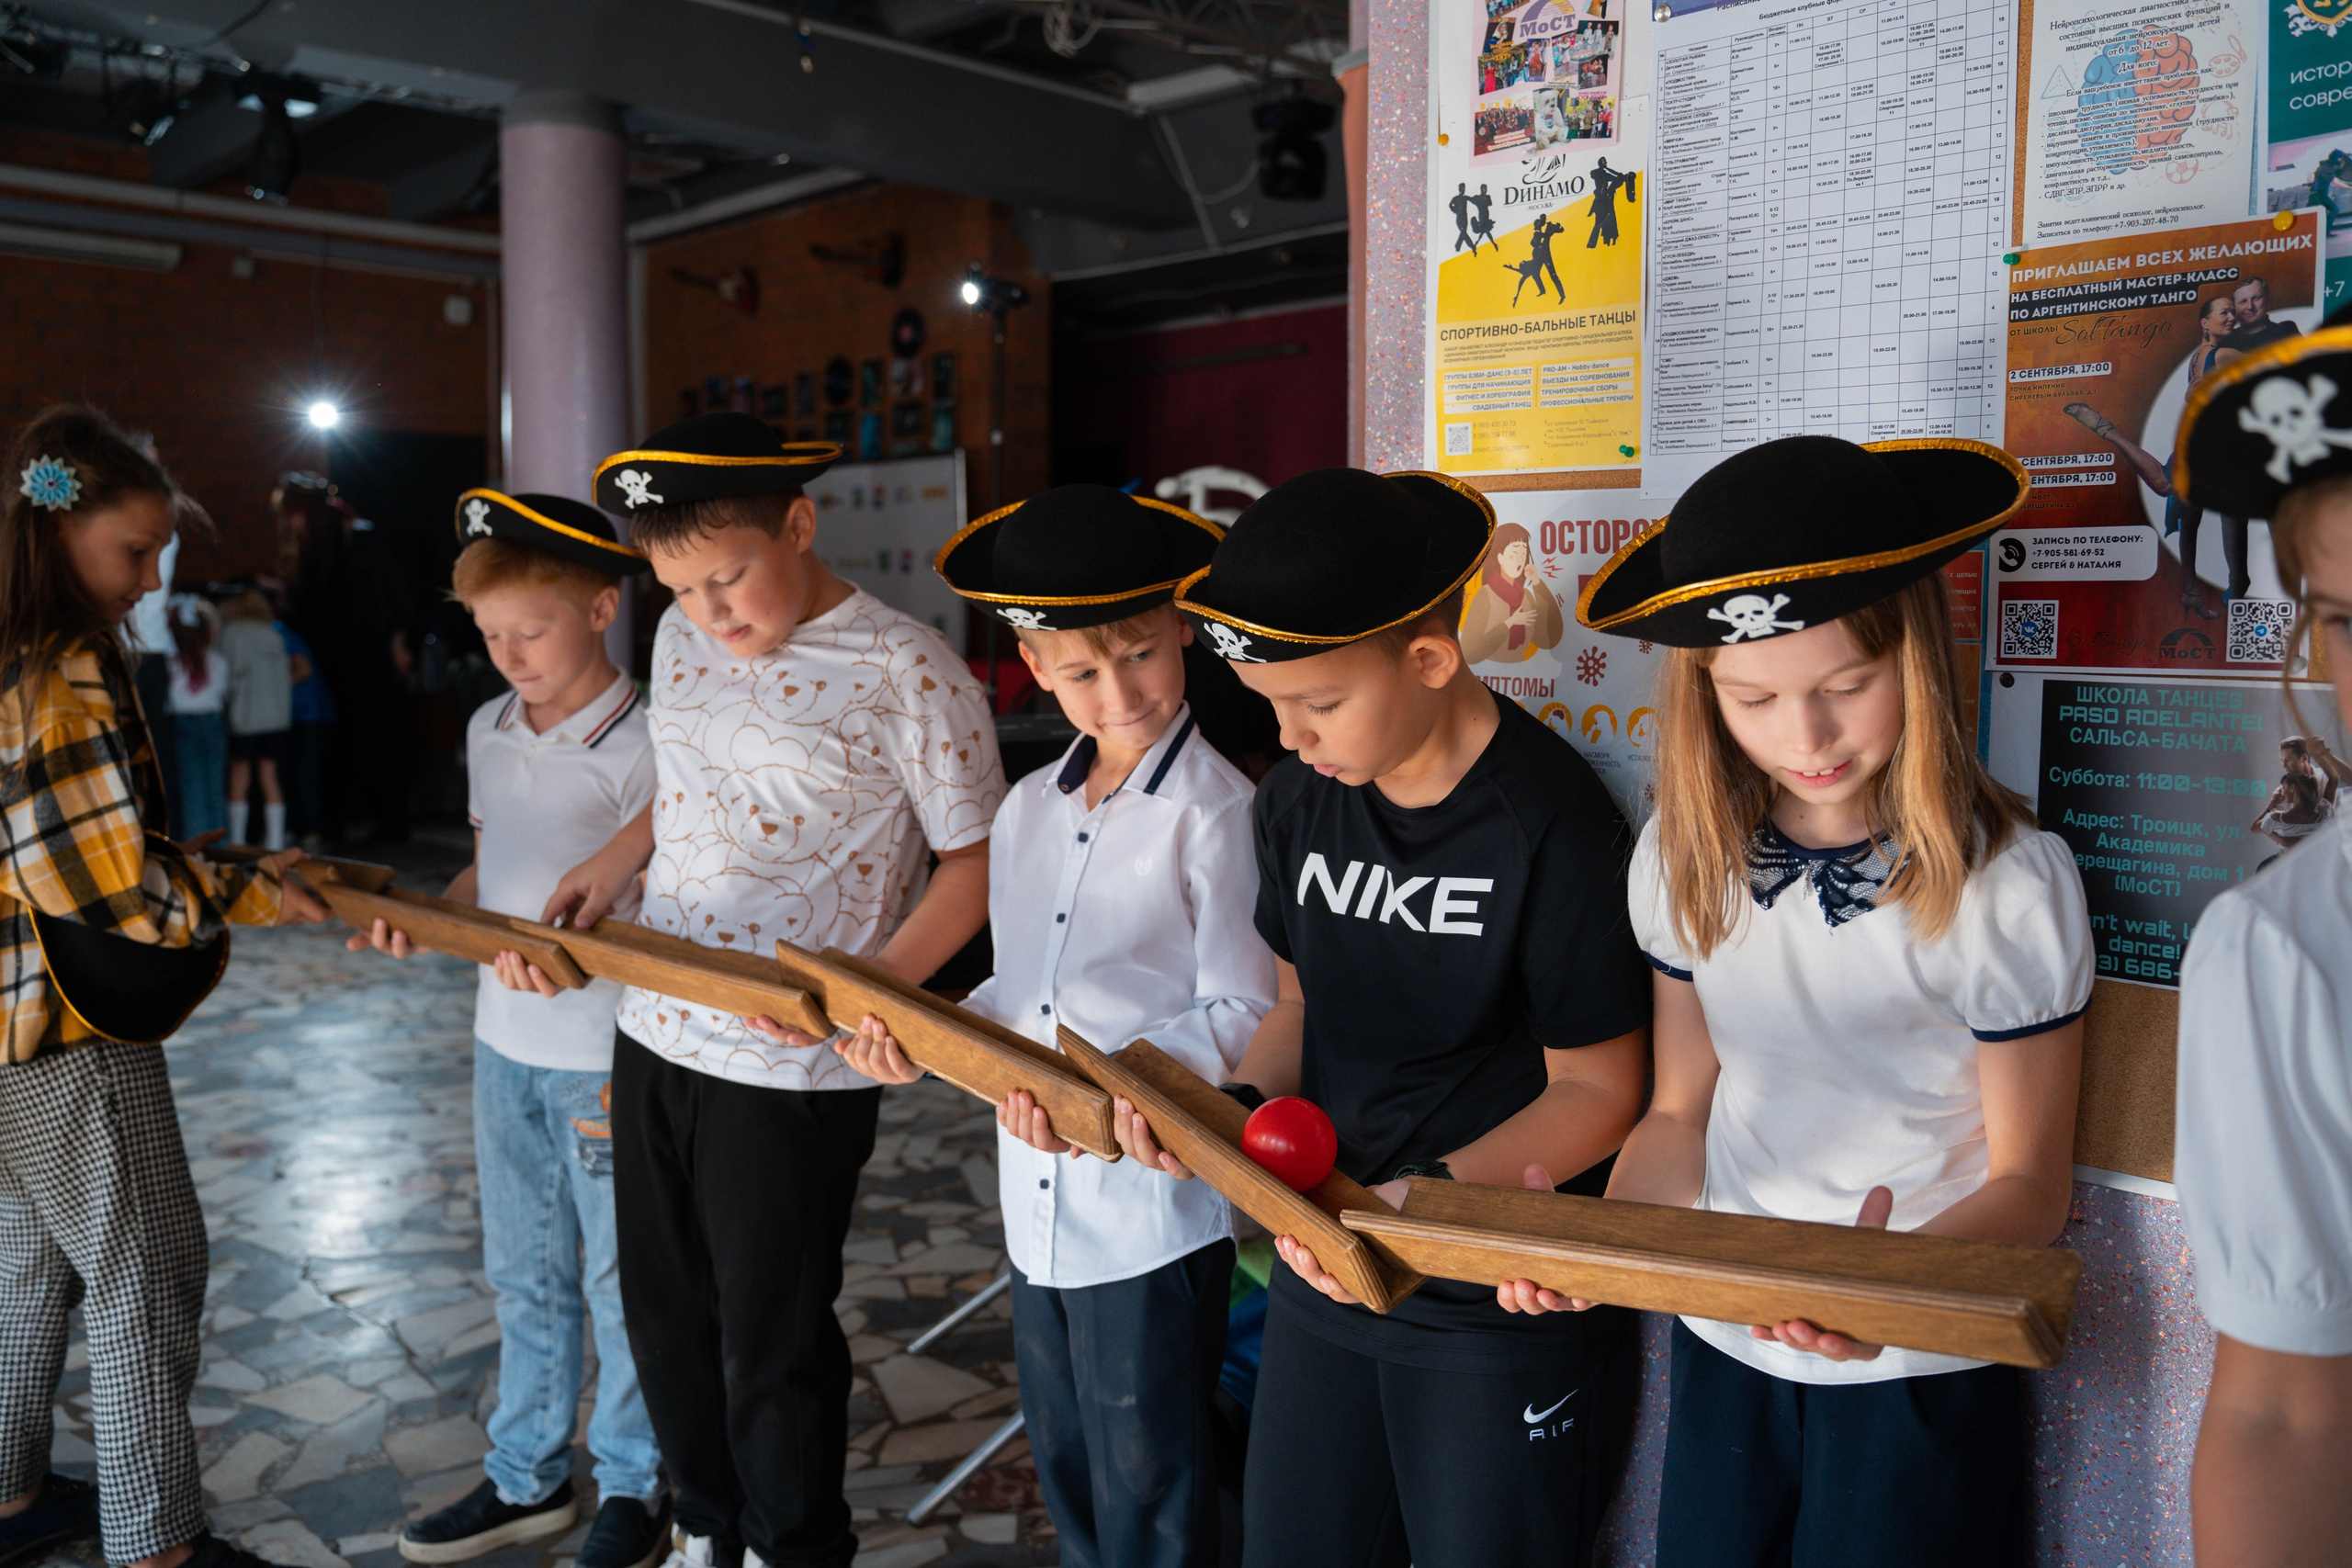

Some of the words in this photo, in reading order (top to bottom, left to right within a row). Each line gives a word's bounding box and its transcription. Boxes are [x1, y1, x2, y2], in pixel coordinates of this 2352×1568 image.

[1758, 7, 1796, 20] Бюджетные
[1797, 1, 1825, 12] клубные
[2050, 8, 2136, 31] Нейропсихологическая
[2059, 28, 2096, 40] состояния
[2098, 22, 2129, 33] высших
[2132, 13, 2182, 27] психических
[2185, 3, 2222, 18] функций
[1520, 14, 1576, 37] МоСТ
[2065, 35, 2126, 52] индивидуальная
[2129, 23, 2194, 39] нейрокоррекция
[2197, 16, 2221, 28] детей
[2118, 45, 2124, 54] 6
[2129, 45, 2140, 53] до
[2143, 40, 2153, 51] 12
[2154, 40, 2171, 49] лет.
[2118, 62, 2134, 73] Для
[2137, 60, 2158, 69] кого:
[2066, 89, 2082, 97] Если
[2097, 82, 2121, 93] ребенок
[2164, 70, 2199, 80] проблемы,
[2048, 107, 2078, 117] школьные
[2081, 102, 2112, 113] трудности
[2115, 97, 2140, 108] (низкая
[2188, 84, 2223, 95] трудности
[2092, 111, 2118, 120] ошибки
[2130, 103, 2168, 114] математике,
[2161, 122, 2193, 130] внимания
[2196, 116, 2234, 127] (трудности
[2045, 169, 2085, 179] двигательная
[2148, 154, 2172, 164] низкий
[2174, 151, 2223, 161] самоконтроль,
[2044, 179, 2088, 188] конфликтность
[2086, 183, 2108, 193] ЗПРР
[2037, 220, 2062, 229] Занятия
[2081, 212, 2120, 223] клинический
[2122, 209, 2153, 219] психолог,
[2154, 204, 2205, 214] нейропсихолог.
[2037, 230, 2071, 239] Записаться
[2083, 224, 2113, 233] телефону:
[2114, 215, 2178, 229] +7-903-207-48-70
[2011, 255, 2131, 283] ПРИГЛАШАЕМ
[2136, 249, 2184, 267] ВСЕХ
[2188, 233, 2313, 262] ЖЕЛАЮЩИХ
[2011, 292, 2029, 303] НА
[2031, 277, 2122, 301] БЕСПЛАТНЫЙ
[2126, 267, 2238, 289] МАСТЕР-КЛАСС
[2324, 280, 2345, 298] +7
[2010, 309, 2030, 321] ПО
[2031, 295, 2148, 318] АРГЕНТИНСКОМУ
[2151, 289, 2197, 304] ТАНГО
[1441, 316, 1587, 342] СПОРТИВНО-БАЛЬНЫЕ
[1589, 310, 1635, 326] ТАНЦЫ
[2023, 325, 2058, 335] ШКОЛЫ
[1444, 373, 1467, 381] ГРУППЫ
[1468, 370, 1503, 379] БЭБИ-ДАНС
[1504, 369, 1520, 378] (3-5)
[1542, 377, 1569, 385] ВЫЕЗДЫ
[1579, 371, 1630, 381] СОРЕВНОВАНИЯ
[2010, 371, 2017, 379] 2
[2018, 366, 2078, 378] СЕНТЯБРЯ,
[2081, 363, 2109, 373] 17:00
[1455, 393, 1480, 401] ФИТНЕС
[1486, 389, 1531, 399] ХОРЕОГРАФИЯ
[1472, 381, 1485, 389] ДЛЯ
[1486, 378, 1531, 388] НАЧИНАЮЩИХ
[1542, 386, 1595, 396] ТРЕНИРОВОЧНЫЕ
[1472, 402, 1510, 411] СВАДЕБНЫЙ
[1540, 396, 1604, 407] ПРОФЕССИОНАЛЬНЫЕ
[2009, 392, 2052, 401] СИРЕНЕВЫЙ
[2021, 456, 2081, 467] СЕНТЯБРЯ,
[2084, 453, 2112, 463] 17:00
[2031, 474, 2083, 485] ЕНТЯБРЯ,
[2086, 472, 2114, 482] 17:00
[1540, 518, 1658, 555] ОСТОР
[2089, 535, 2143, 544] ТЕЛЕФОНУ:
[2031, 548, 2105, 557] +7-905-581-69-52
[2031, 559, 2066, 570] СЕРГЕЙ
[2077, 560, 2121, 569] НАТАЛИЯ
[2076, 686, 2150, 705] ШКОЛА
[2157, 689, 2243, 711] ТАНЦЕВ
[2059, 705, 2119, 724] PASO
[2125, 708, 2263, 732] ADELANTE!
[2070, 727, 2246, 753] САЛЬСА-БАЧАТА
[2049, 766, 2130, 788] Суббота:
[2136, 772, 2267, 798] 11:00-13:00
[2063, 808, 2124, 830] Адрес:
[2130, 814, 2209, 840] Троицк,
[2215, 824, 2246, 842] ул.
[2096, 832, 2205, 858] Академика
[2074, 853, 2180, 878] ерещагина,
[2187, 864, 2227, 882] дом
[2233, 865, 2245, 882] 1
[1297, 852, 1494, 936] NIKE
[2088, 914, 2119, 931] n't
[2124, 919, 2177, 942] wait,
[2109, 935, 2181, 961] dance!
